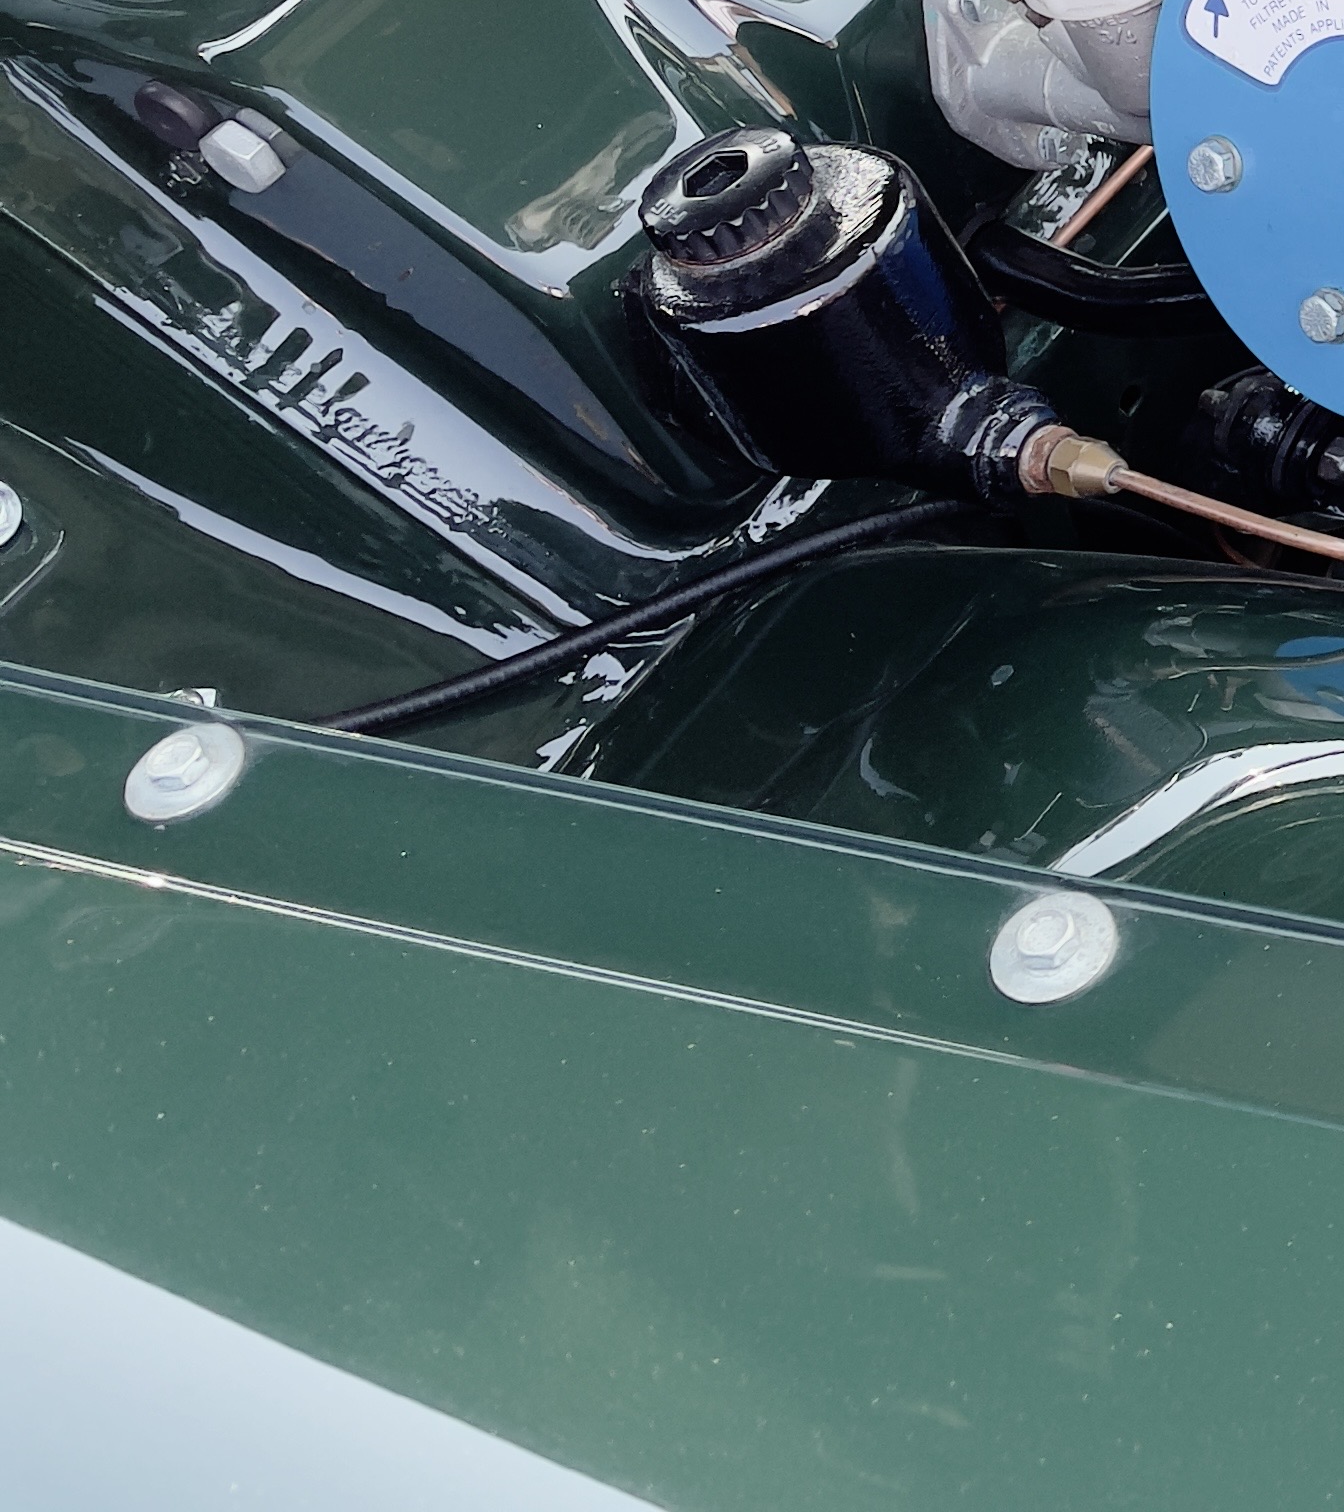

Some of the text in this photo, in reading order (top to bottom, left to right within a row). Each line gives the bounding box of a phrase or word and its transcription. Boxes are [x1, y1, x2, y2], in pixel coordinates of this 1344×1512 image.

[1272, 6, 1307, 33] MADE
[1316, 0, 1330, 12] IN
[1263, 28, 1305, 77] PATENTS
